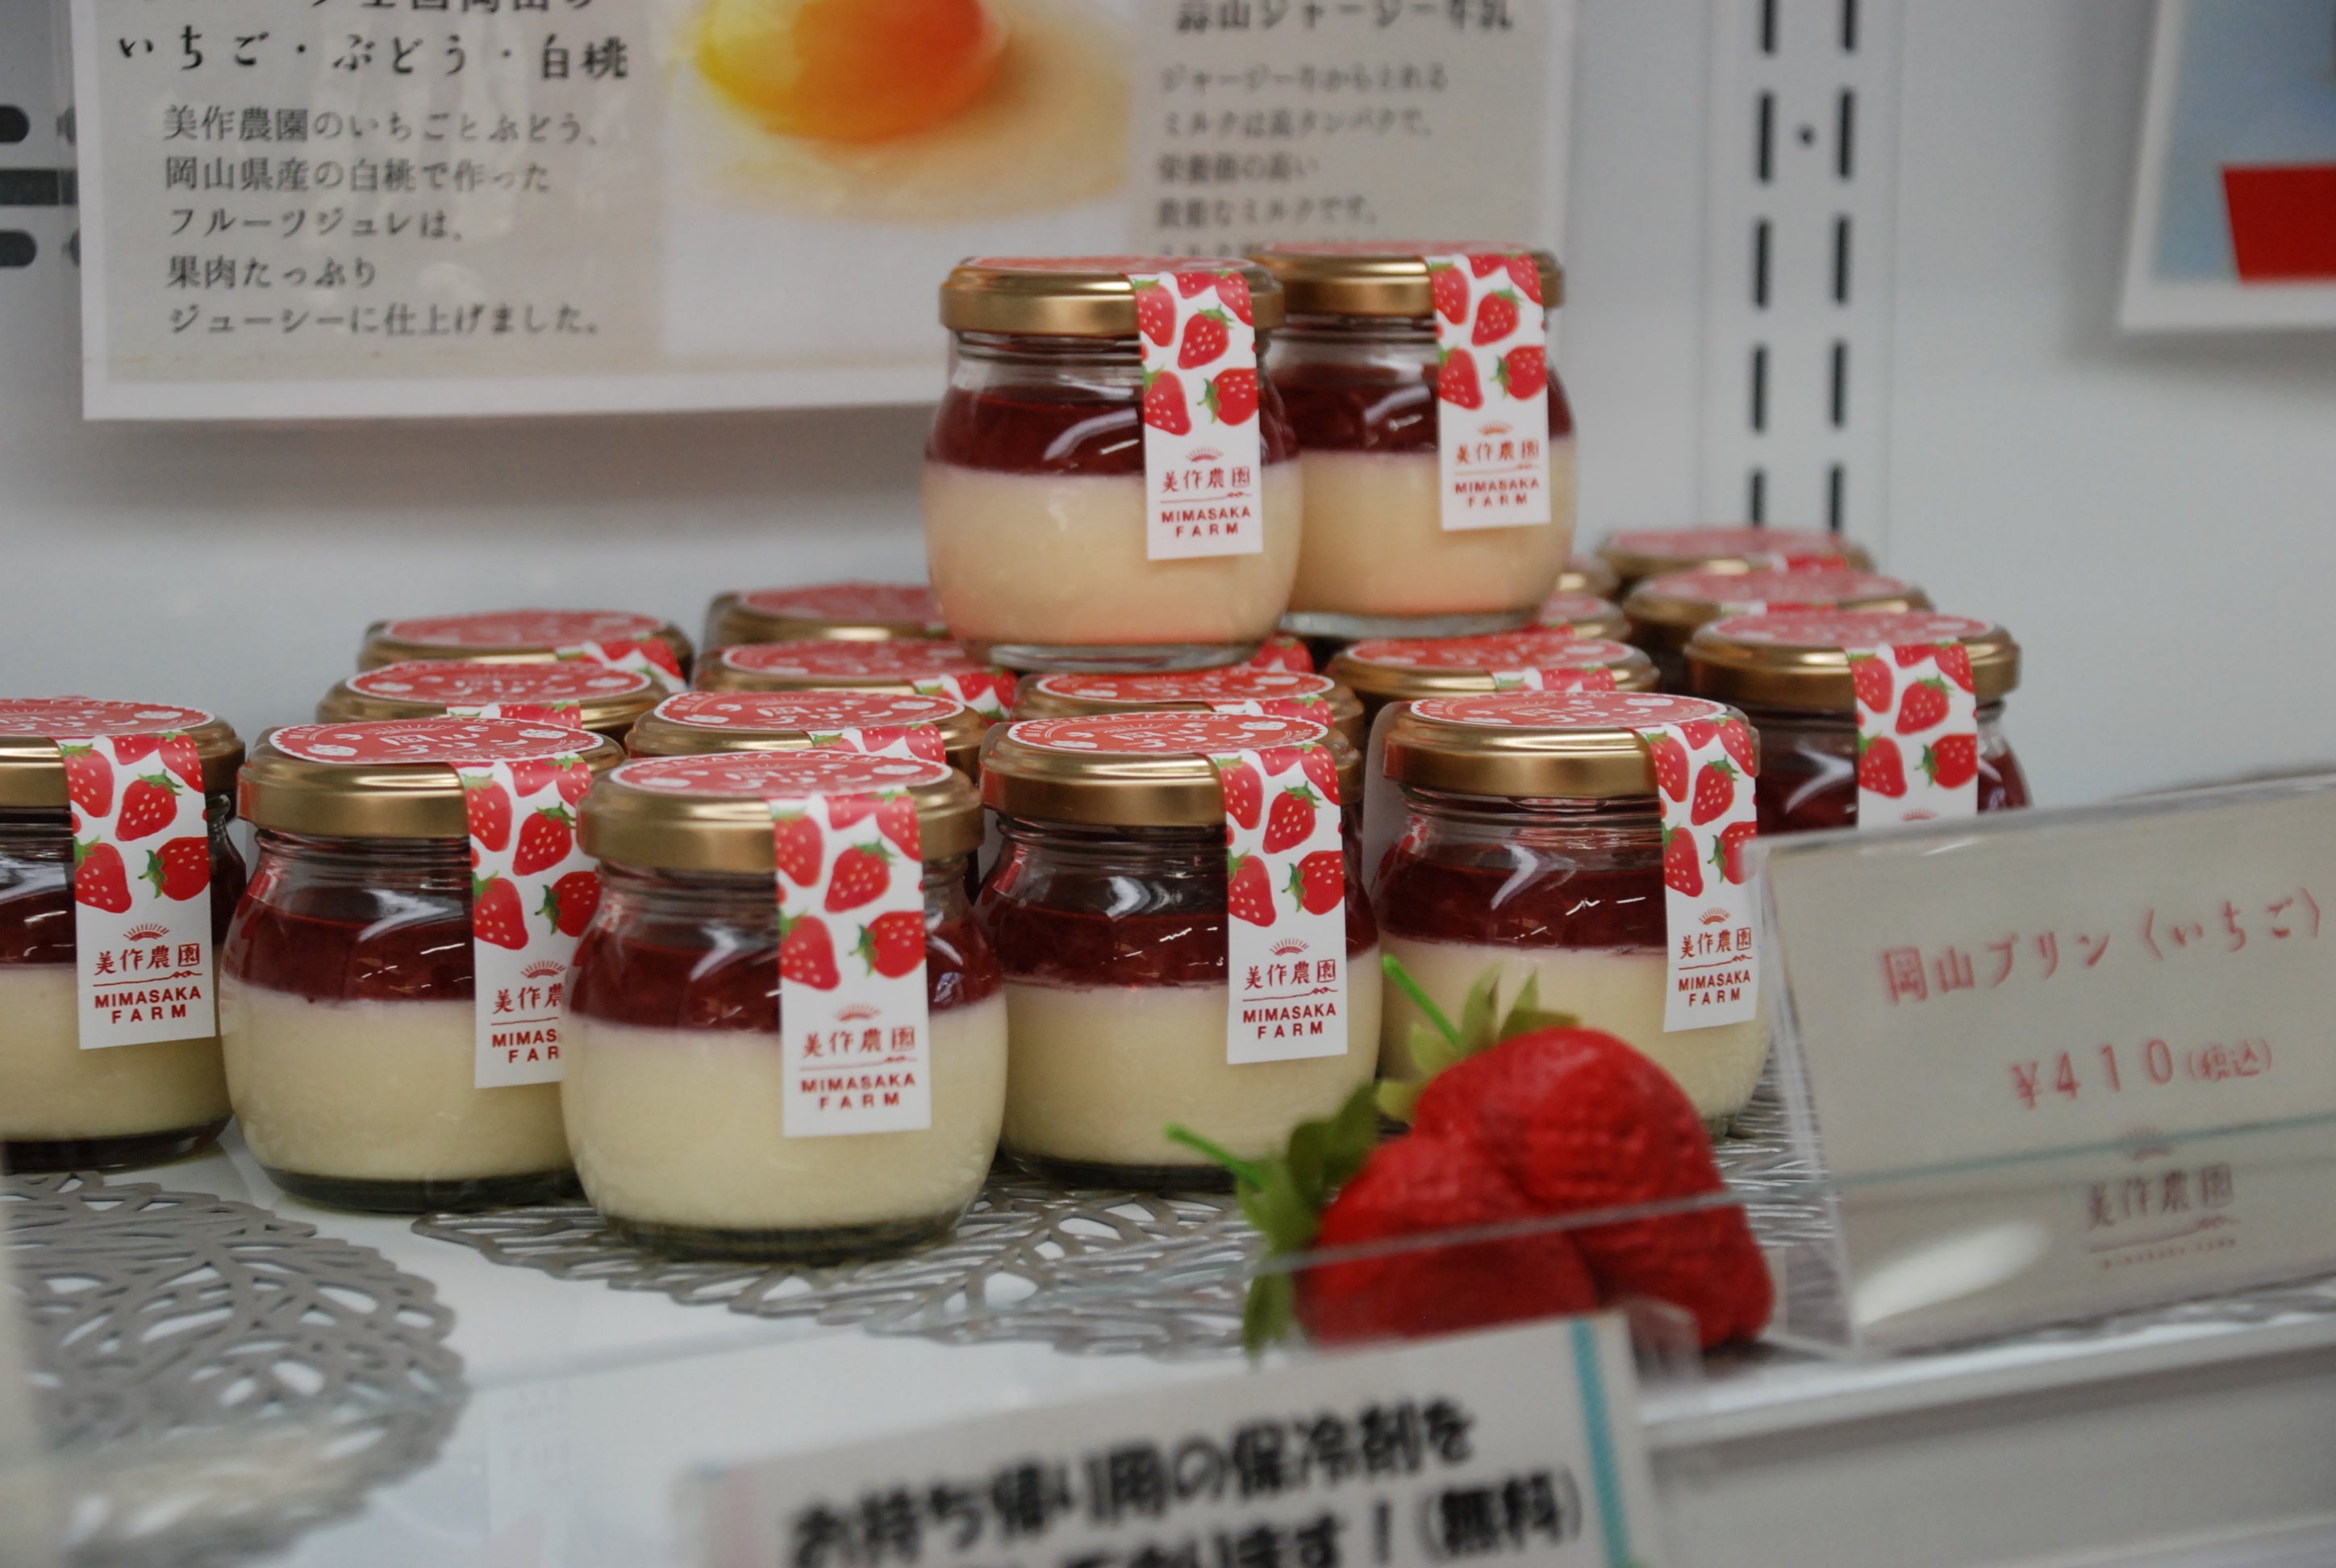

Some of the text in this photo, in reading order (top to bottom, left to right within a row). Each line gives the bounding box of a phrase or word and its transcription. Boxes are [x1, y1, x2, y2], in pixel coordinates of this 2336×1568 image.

[165, 155, 552, 193] 岡山県産の白桃で作った
[166, 254, 376, 289] 果肉たっぷり
[1454, 477, 1540, 494] MIMASAKA
[1466, 493, 1528, 508] FARM
[1161, 506, 1252, 523] MIMASAKA
[1175, 523, 1239, 538] FARM
[1679, 927, 1751, 960] 美作農園
[94, 943, 200, 976] 美作農園
[1244, 959, 1336, 990] 美作農園
[1678, 970, 1751, 992] MIMASAKA
[94, 986, 202, 1008] MIMASAKA
[1688, 987, 1741, 1007] FARM
[111, 1004, 187, 1024] FARM
[1242, 1003, 1337, 1024] MIMASAKA
[491, 1028, 557, 1048] MIMAS
[1257, 1020, 1323, 1040] FARM
[507, 1046, 561, 1064] FAR
[800, 1072, 916, 1094] MIMASAKA
[819, 1091, 900, 1111] FARM
